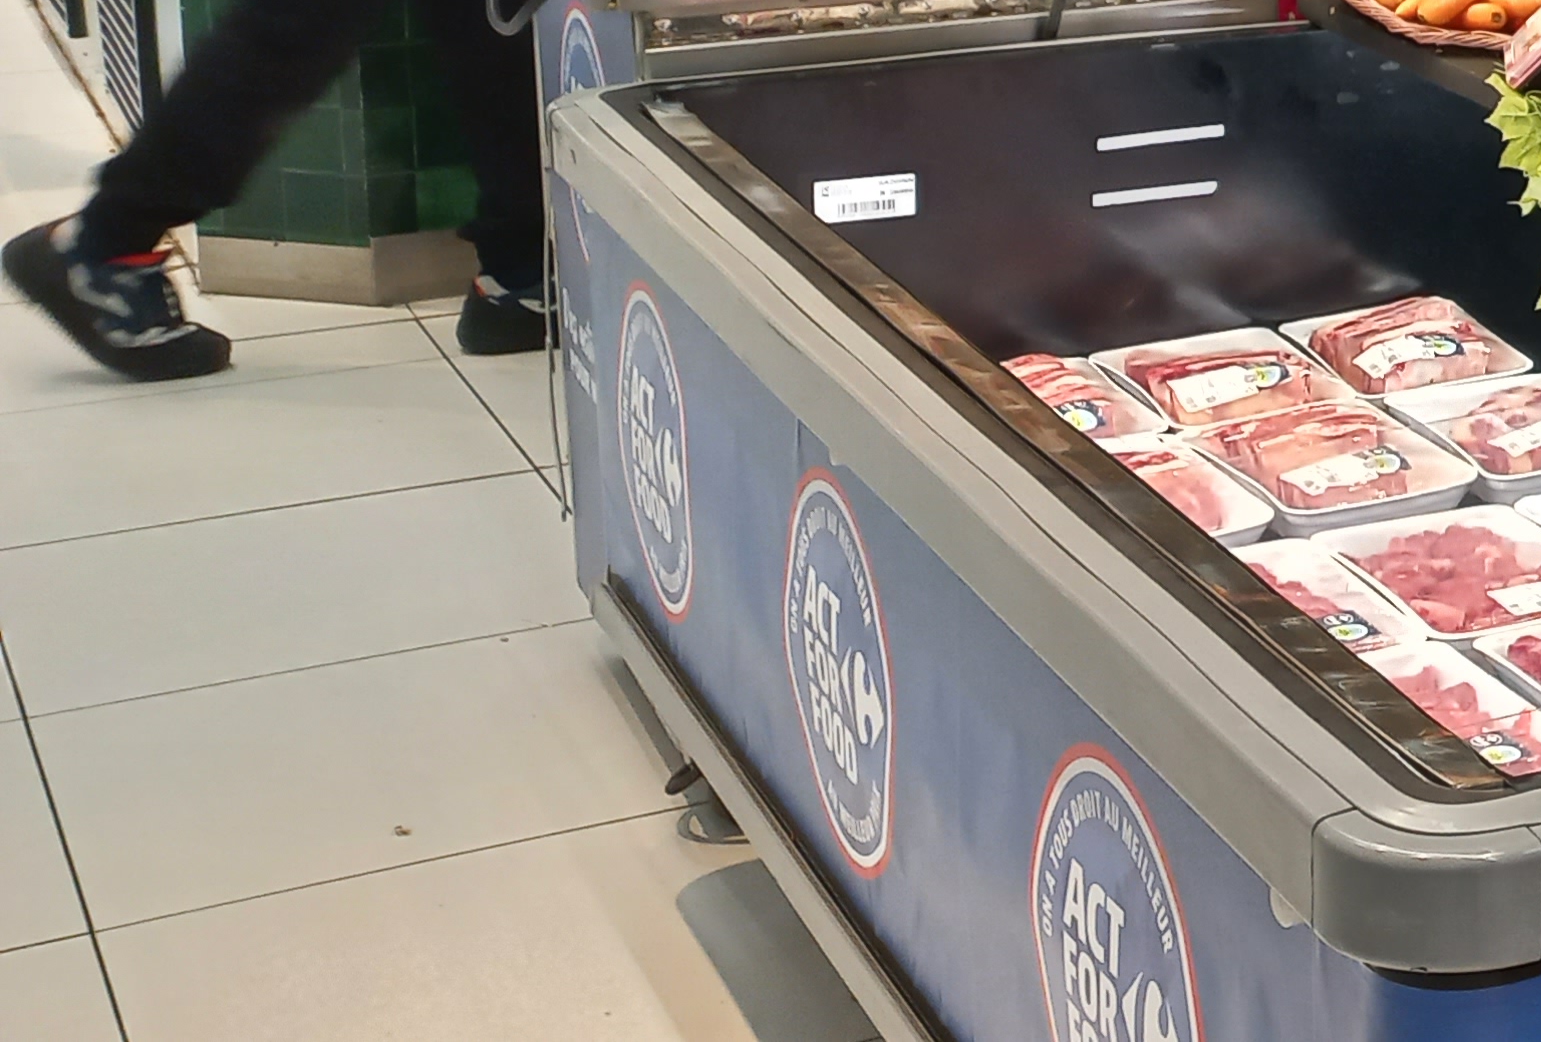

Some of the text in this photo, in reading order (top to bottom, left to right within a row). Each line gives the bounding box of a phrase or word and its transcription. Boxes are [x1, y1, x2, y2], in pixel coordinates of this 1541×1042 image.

[804, 564, 842, 657] ACT
[803, 625, 843, 716] FOR
[808, 680, 858, 787] FOOD
[1041, 788, 1174, 954] ON A TOUS DROIT AU MEILLEUR
[1062, 857, 1125, 980] ACT
[1062, 928, 1119, 1039] FOR
